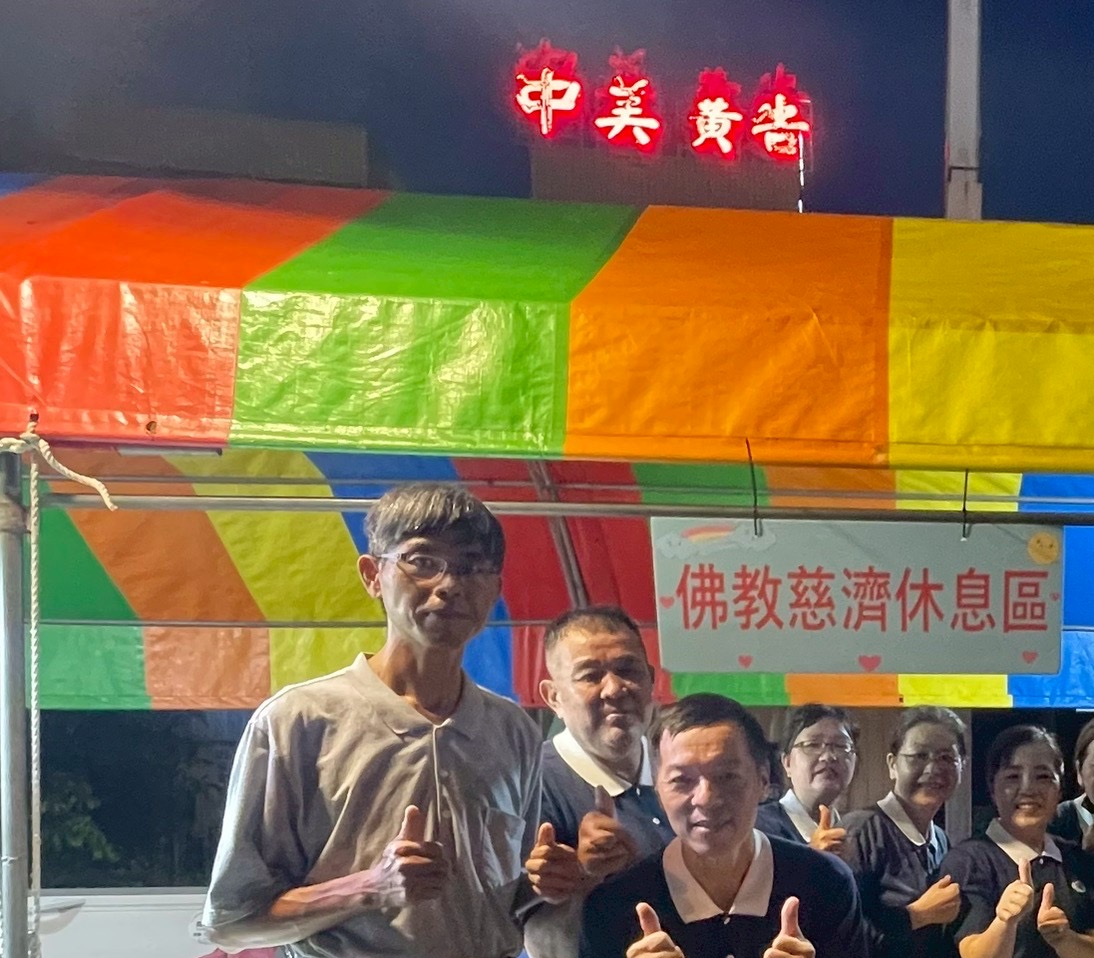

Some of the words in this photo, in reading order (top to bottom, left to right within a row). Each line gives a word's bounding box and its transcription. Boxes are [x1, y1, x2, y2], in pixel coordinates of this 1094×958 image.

[676, 563, 1050, 633] 佛教慈濟休息區
